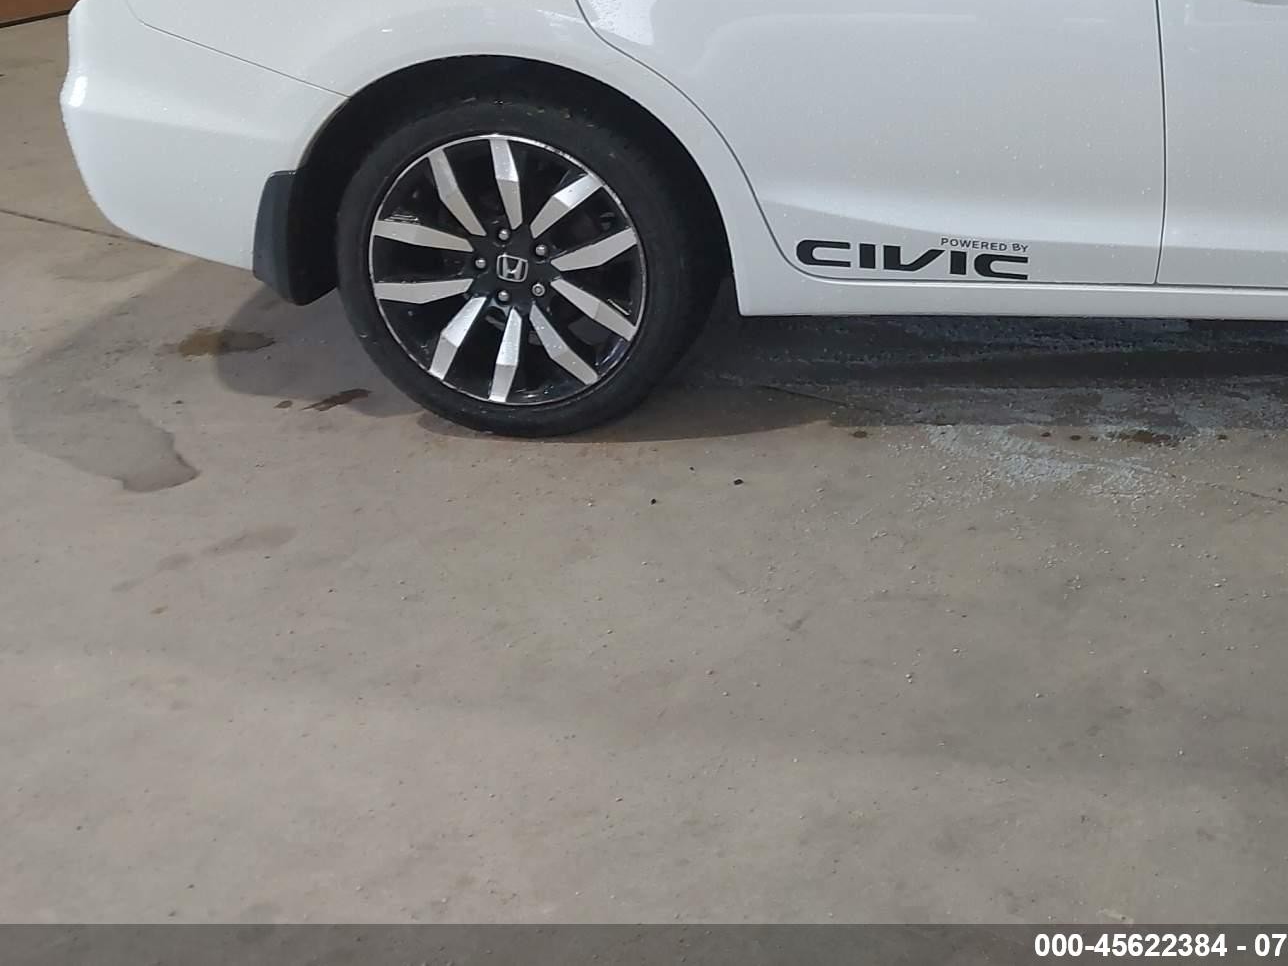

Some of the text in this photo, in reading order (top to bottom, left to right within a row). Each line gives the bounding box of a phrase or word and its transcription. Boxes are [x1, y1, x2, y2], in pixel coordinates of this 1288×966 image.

[941, 237, 1029, 253] POWERED BY
[796, 239, 1028, 280] CIVIC
